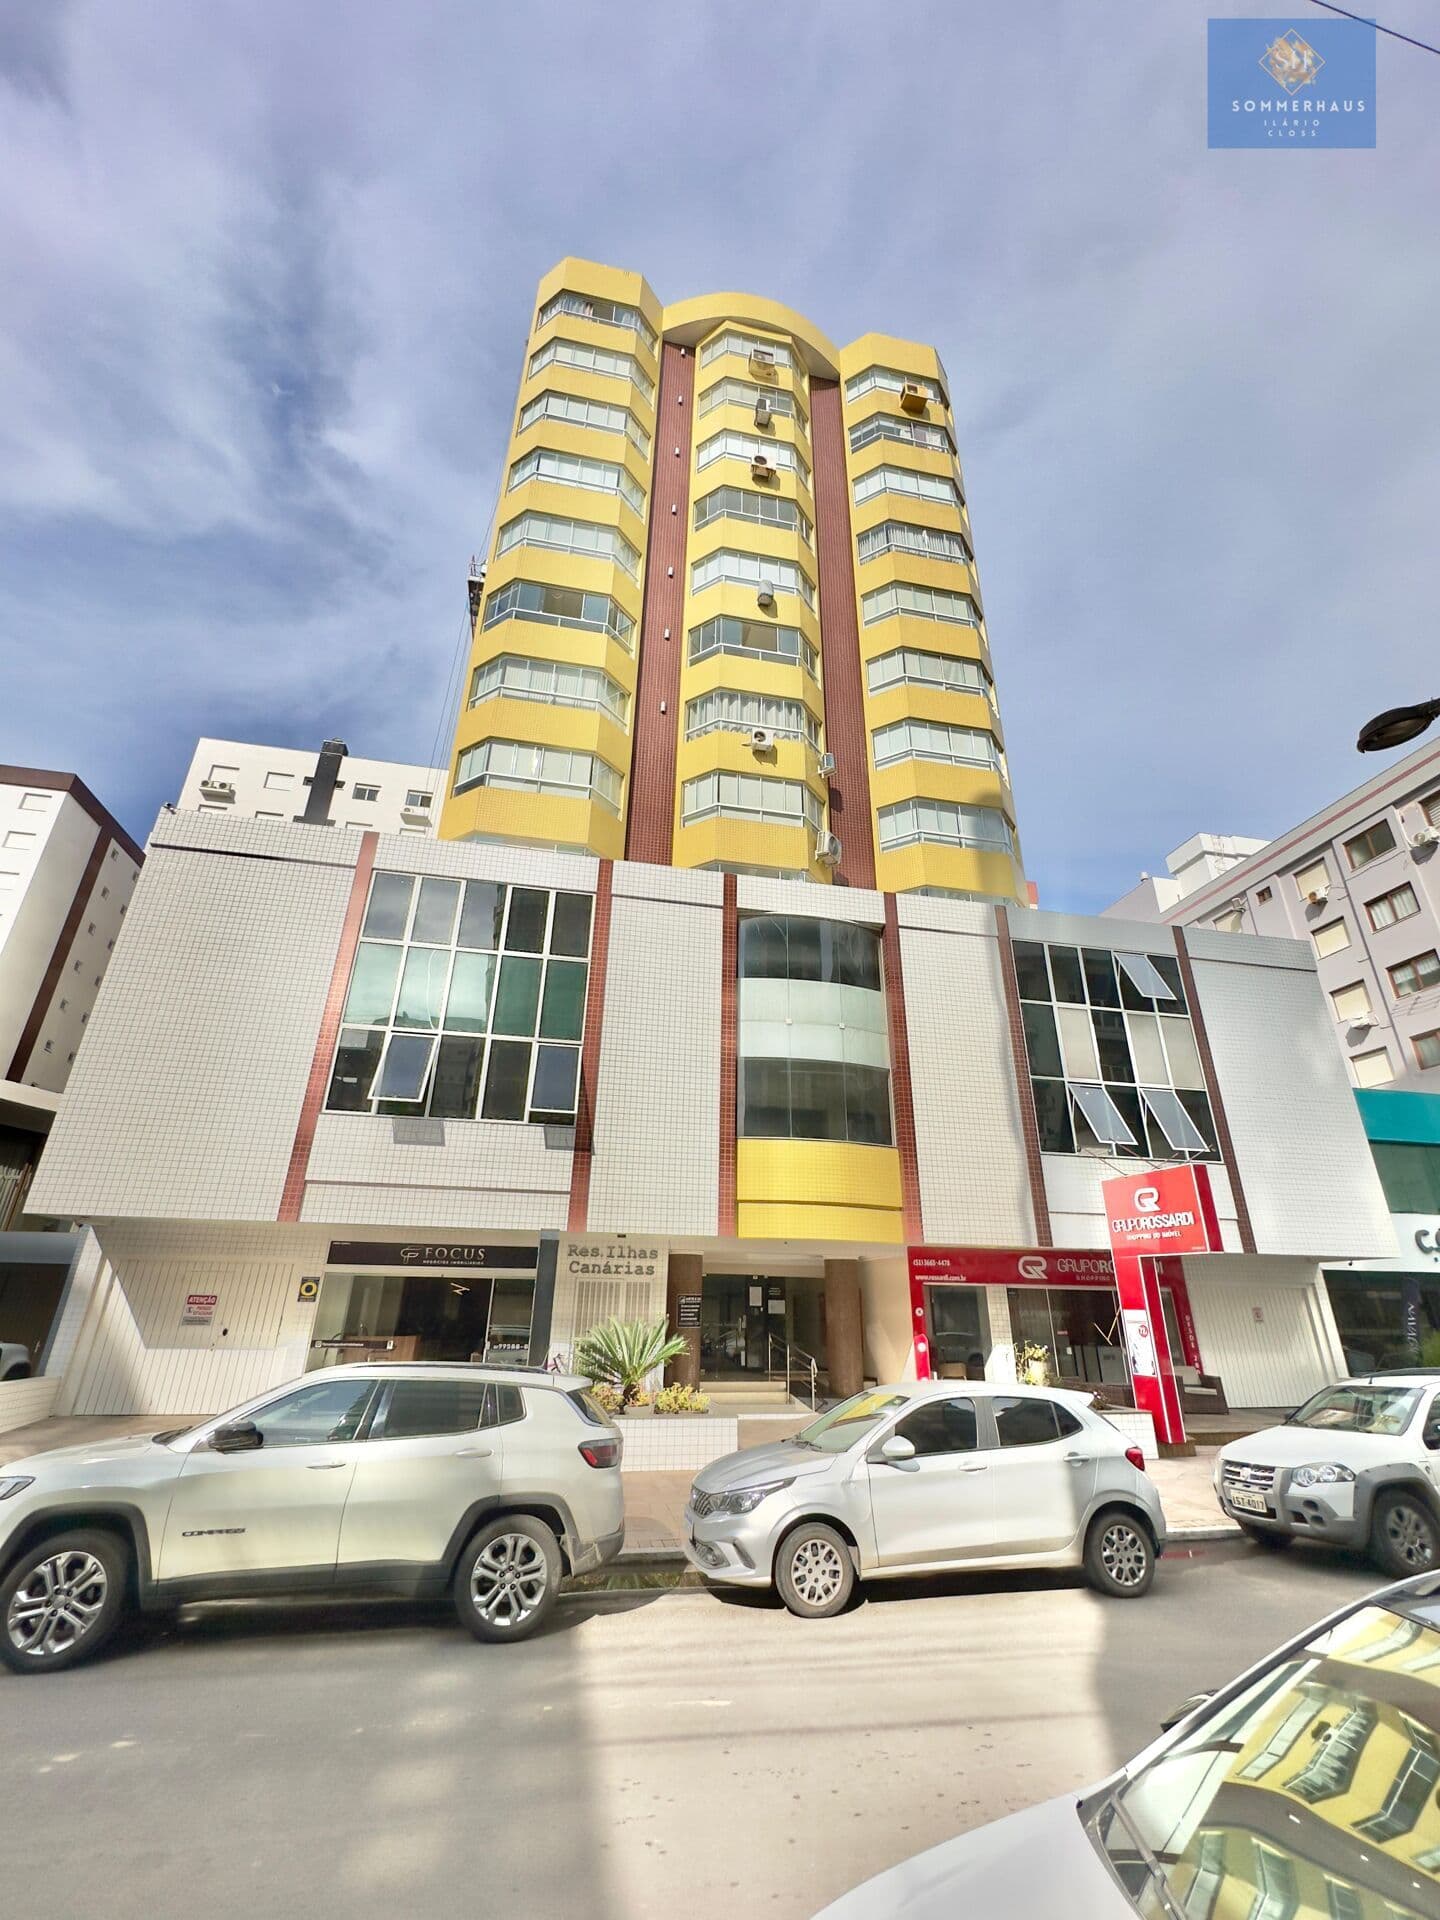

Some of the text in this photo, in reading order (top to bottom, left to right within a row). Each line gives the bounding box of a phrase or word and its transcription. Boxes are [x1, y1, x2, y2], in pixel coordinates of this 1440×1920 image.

[425, 1247, 486, 1261] FOCUS
[569, 1261, 655, 1275] Canárias
[188, 1295, 216, 1304] ATENÇÃO
[182, 1528, 246, 1537] COMPASS
